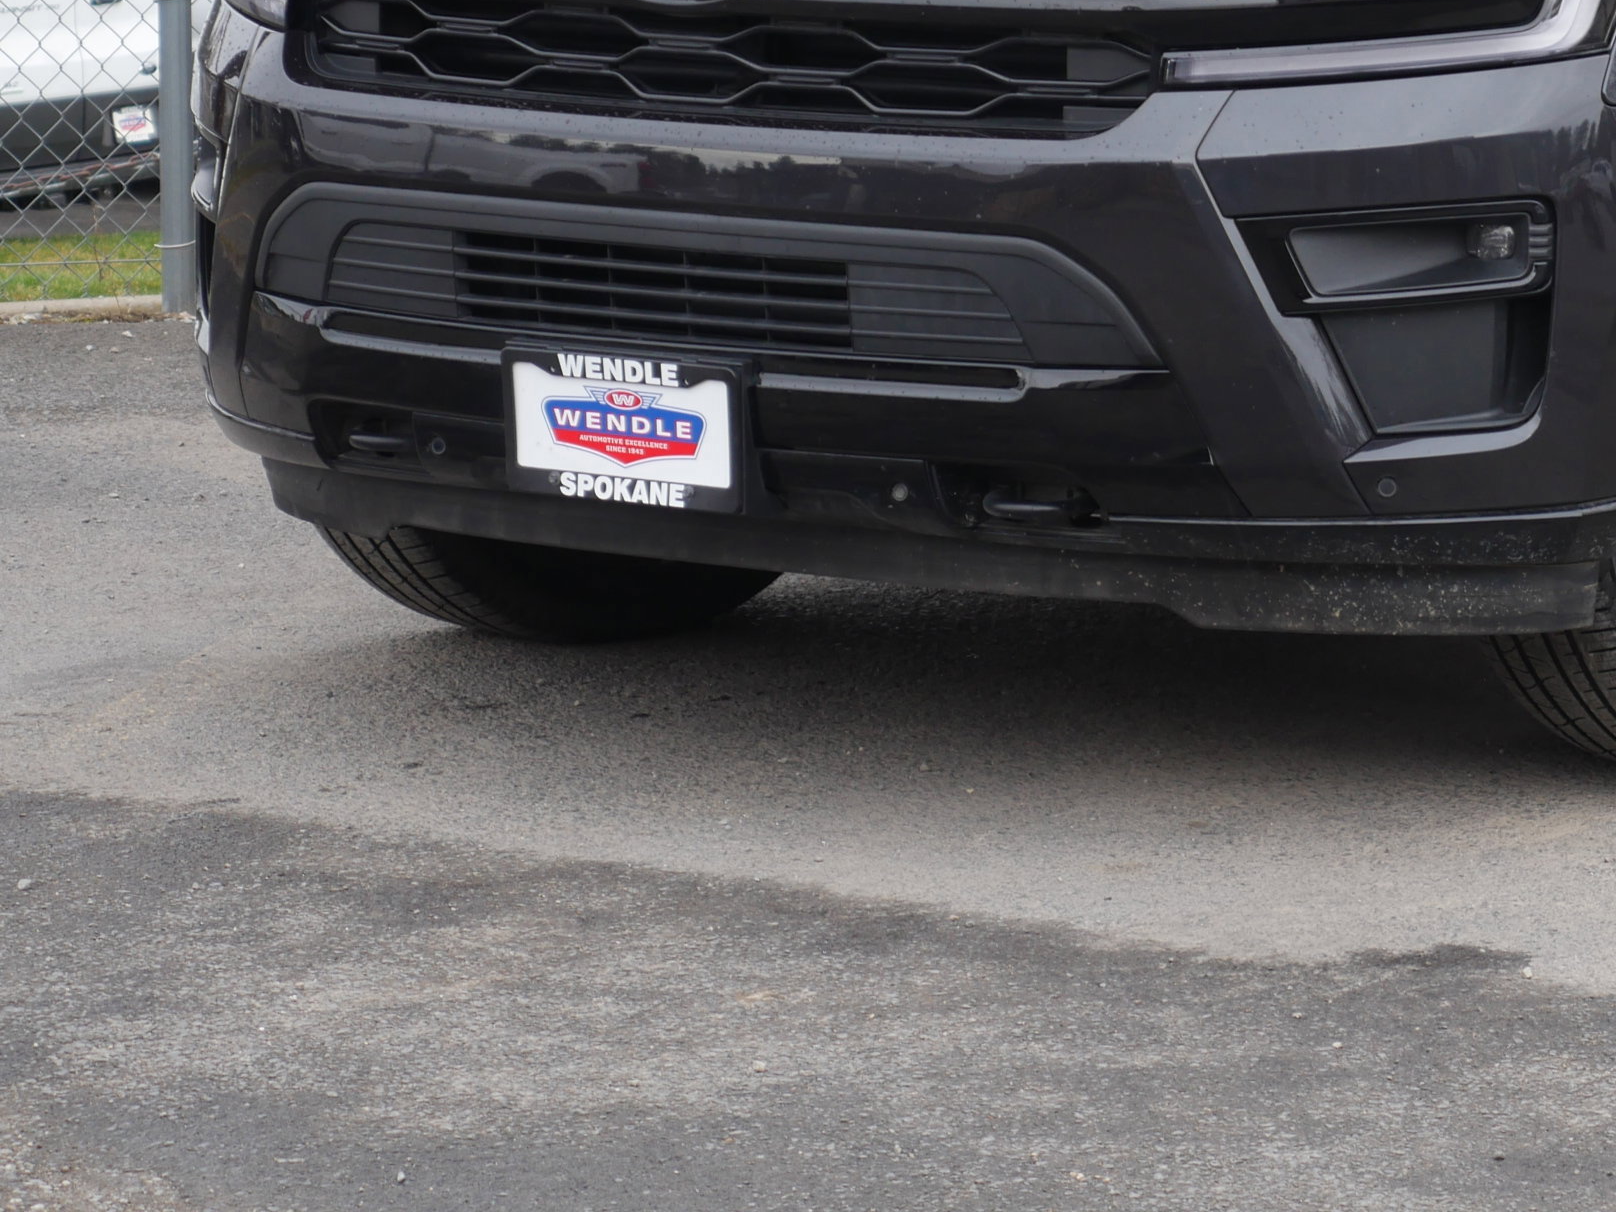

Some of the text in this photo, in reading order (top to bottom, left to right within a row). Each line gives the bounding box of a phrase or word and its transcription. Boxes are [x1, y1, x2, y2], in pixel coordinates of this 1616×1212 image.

[557, 353, 680, 387] WENDLE
[553, 407, 693, 439] WENDLE
[579, 434, 668, 450] AUTOMOTIVE EXCELLENCE
[605, 445, 645, 455] SINCE 1943
[559, 471, 686, 508] SPOKANE
